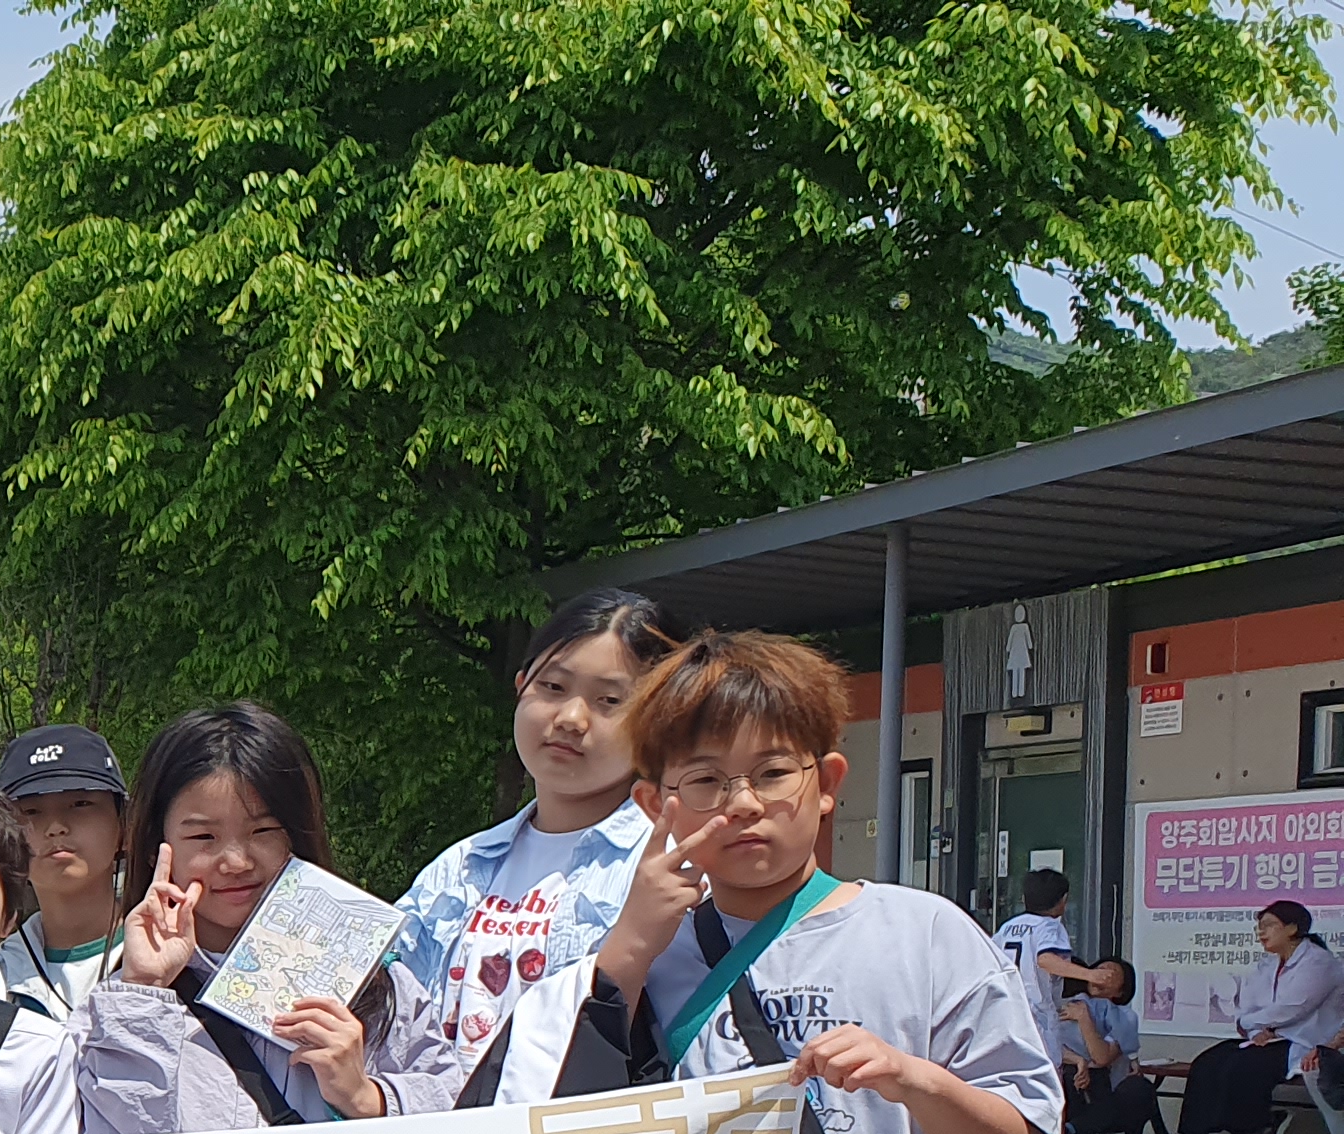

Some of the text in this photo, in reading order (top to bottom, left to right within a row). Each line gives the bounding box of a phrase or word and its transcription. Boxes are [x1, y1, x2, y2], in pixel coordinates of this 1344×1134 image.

[1161, 814, 1277, 849] 양주회암사지
[1155, 850, 1344, 893] 무단투기 행위 금
